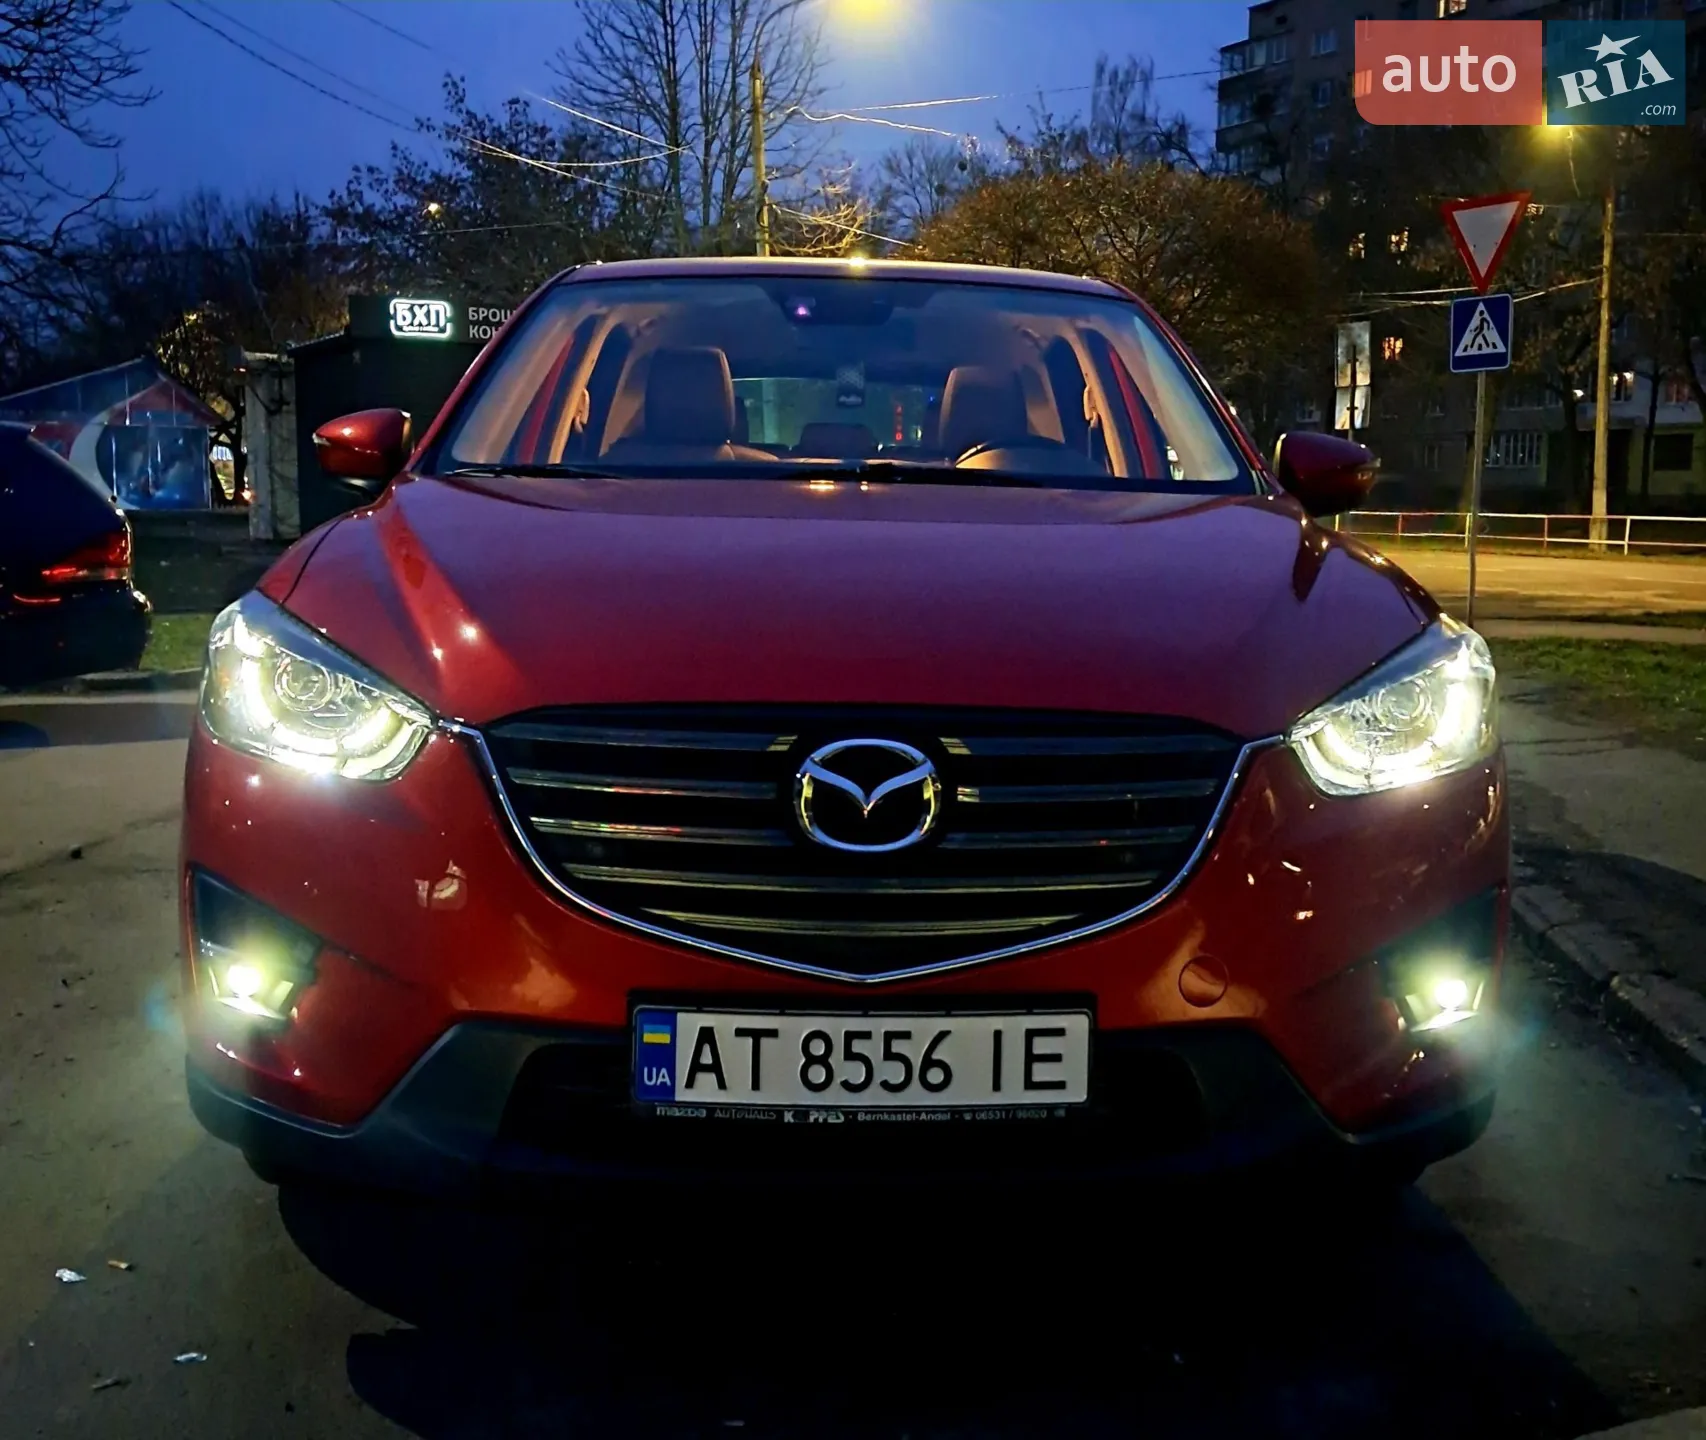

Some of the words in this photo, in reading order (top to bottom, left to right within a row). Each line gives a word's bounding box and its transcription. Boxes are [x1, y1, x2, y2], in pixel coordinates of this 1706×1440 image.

[395, 303, 446, 327] БХП
[684, 1025, 779, 1092] AT
[800, 1028, 954, 1094] 8556
[991, 1027, 1067, 1092] IE
[643, 1067, 671, 1087] UA
